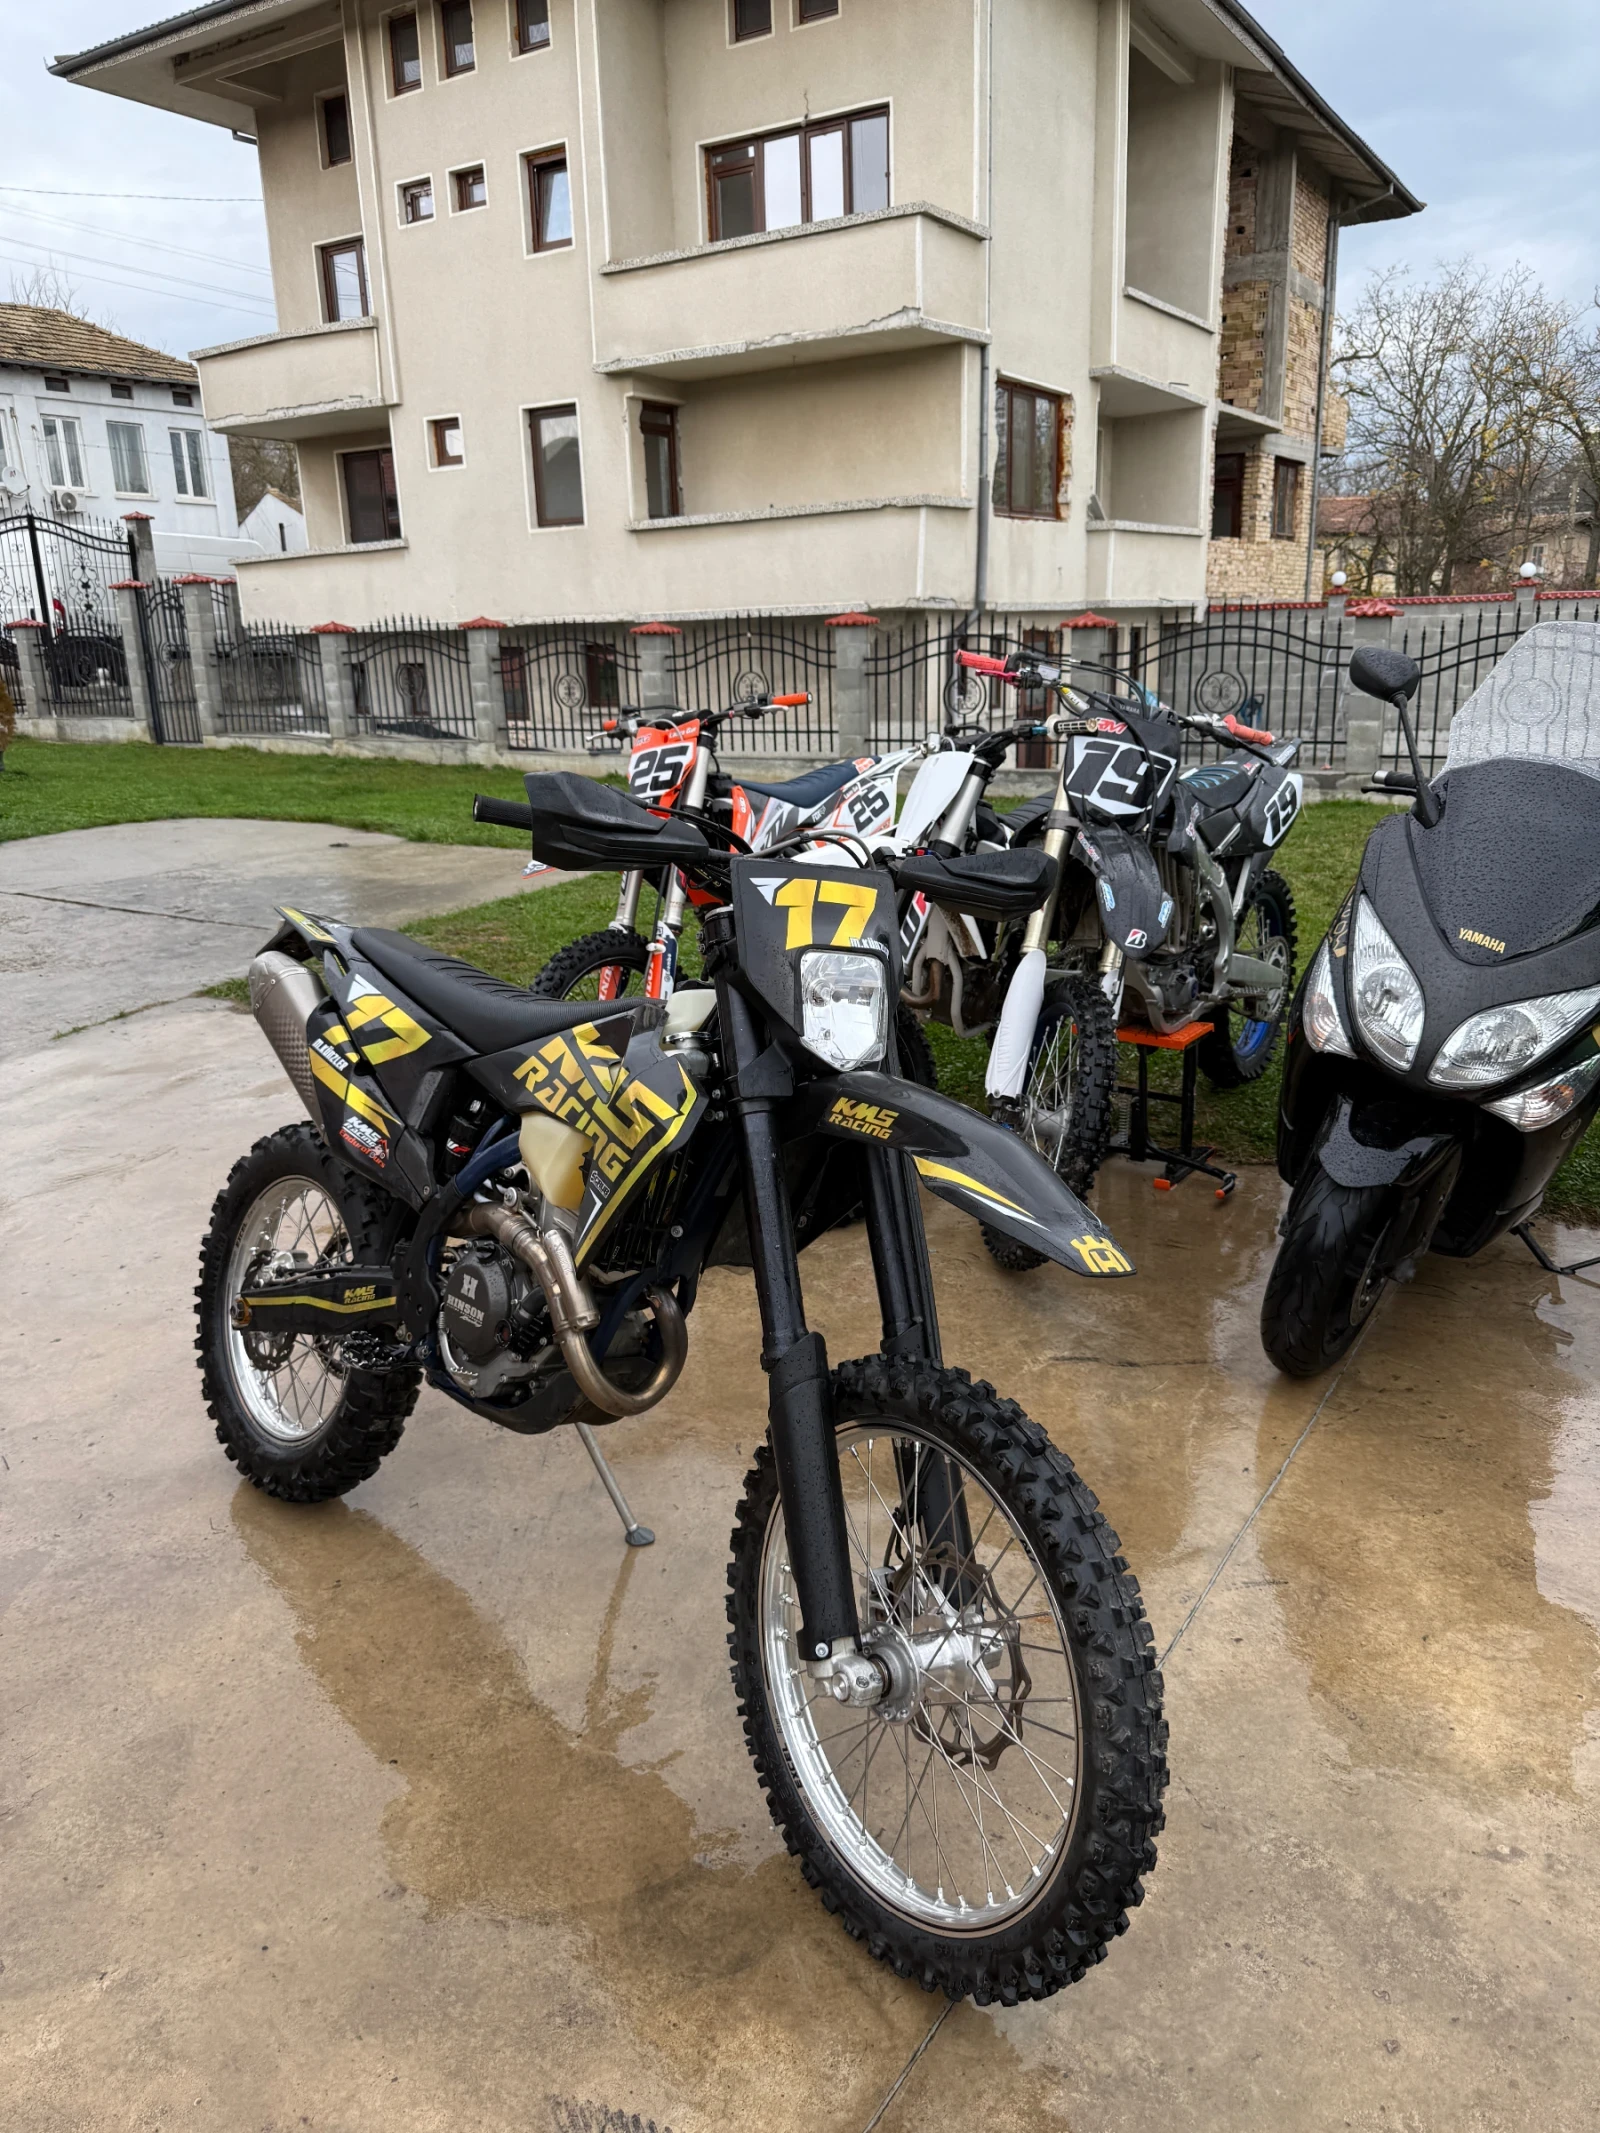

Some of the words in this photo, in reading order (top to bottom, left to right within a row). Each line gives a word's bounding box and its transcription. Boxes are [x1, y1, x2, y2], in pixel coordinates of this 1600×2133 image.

[630, 745, 690, 796] 25
[1065, 740, 1173, 808] 19
[848, 790, 890, 834] 25
[1264, 780, 1298, 842] 19
[775, 878, 878, 951] 17
[1458, 927, 1506, 954] YAMAHA
[345, 995, 433, 1066] 17
[347, 1115, 383, 1143] KMS
[512, 1055, 632, 1183] RACING
[828, 1113, 893, 1140] RACING
[831, 1096, 900, 1129] KMS
[343, 1284, 377, 1300] KMS
[446, 1294, 485, 1322] HINSON
[782, 1742, 804, 1789] EXCEL
